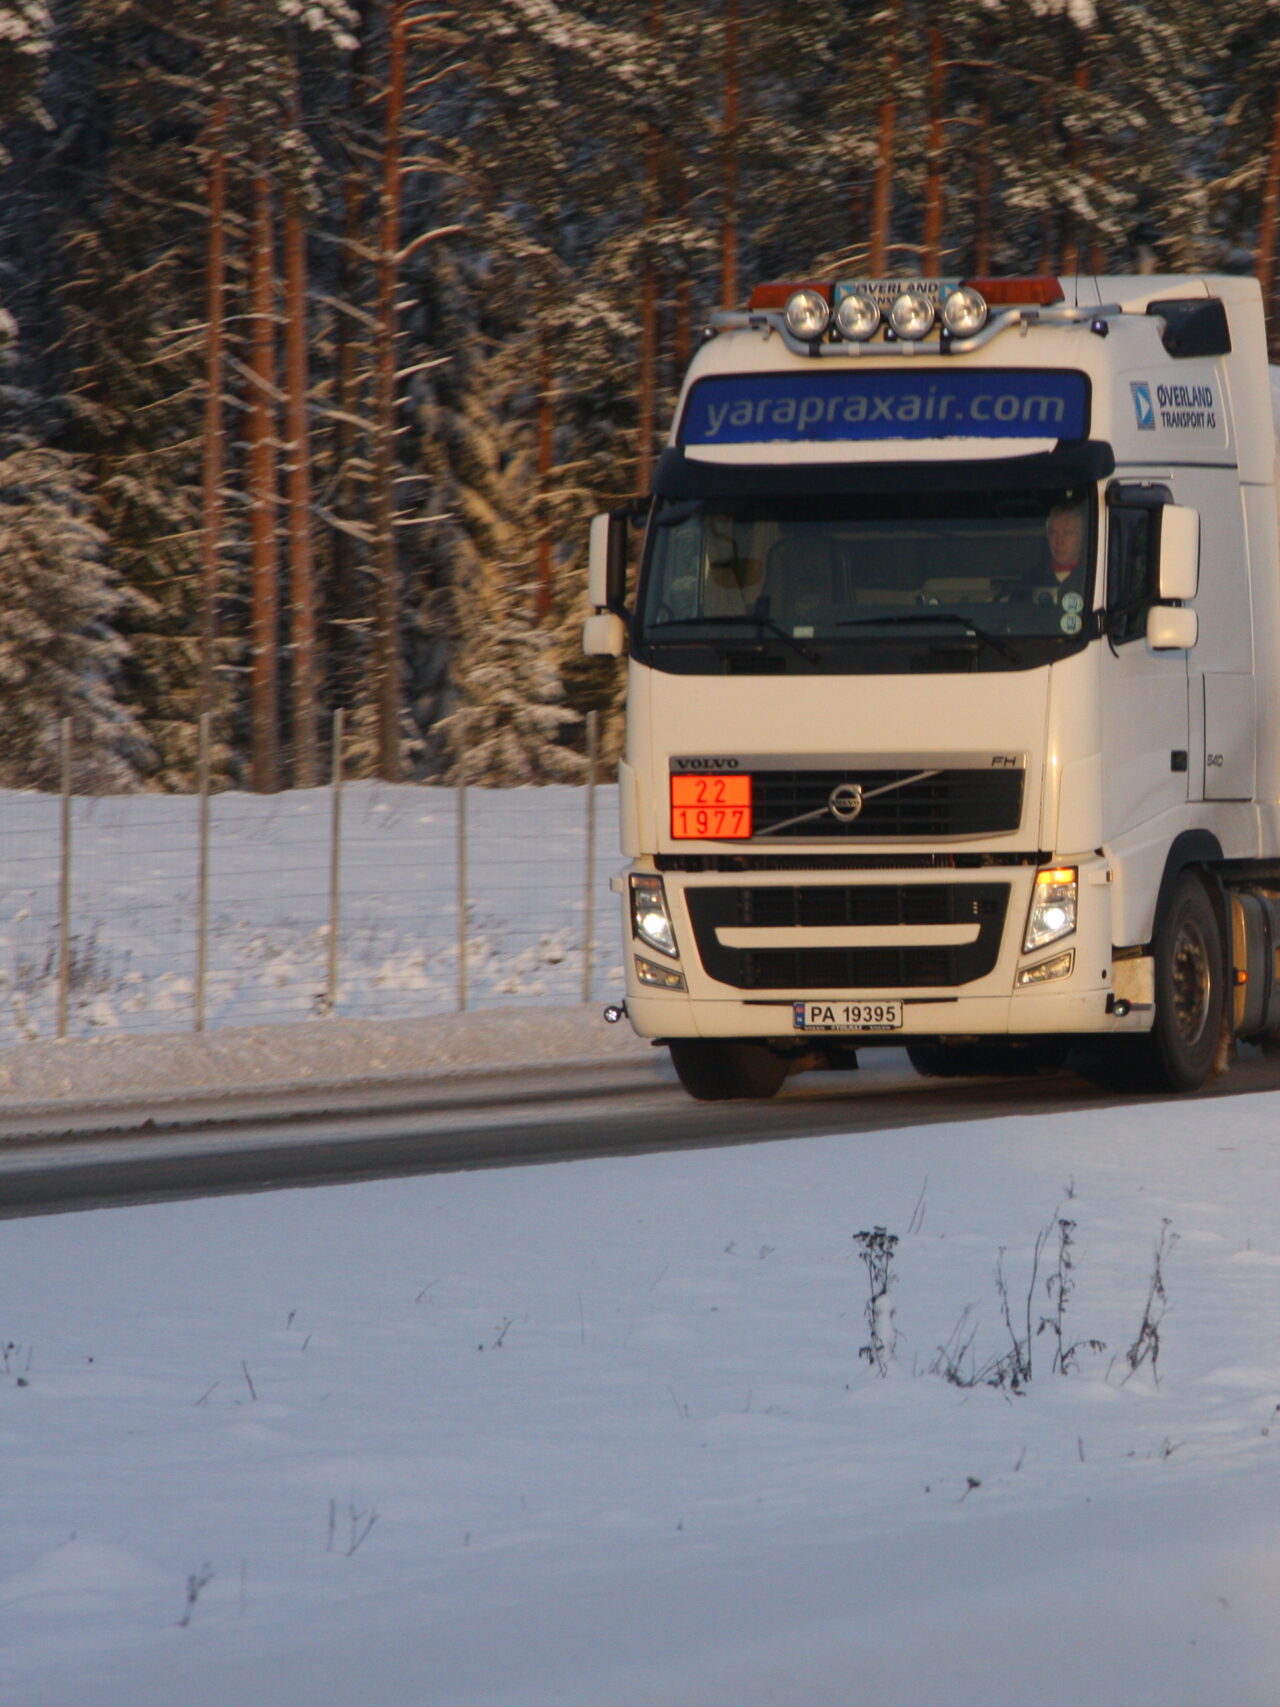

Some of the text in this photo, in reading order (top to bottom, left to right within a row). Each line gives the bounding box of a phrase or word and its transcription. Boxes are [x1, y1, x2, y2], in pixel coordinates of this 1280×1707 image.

[1156, 384, 1213, 408] ØVERLAND
[705, 387, 1065, 436] yarapraxair.com
[1161, 411, 1216, 428] TRANSPORT AS
[676, 759, 739, 769] VOLVO
[991, 755, 1016, 767] FH
[695, 780, 726, 803] 22
[679, 810, 744, 835] 1977
[811, 1006, 835, 1023] PA
[843, 1006, 896, 1023] 19395
